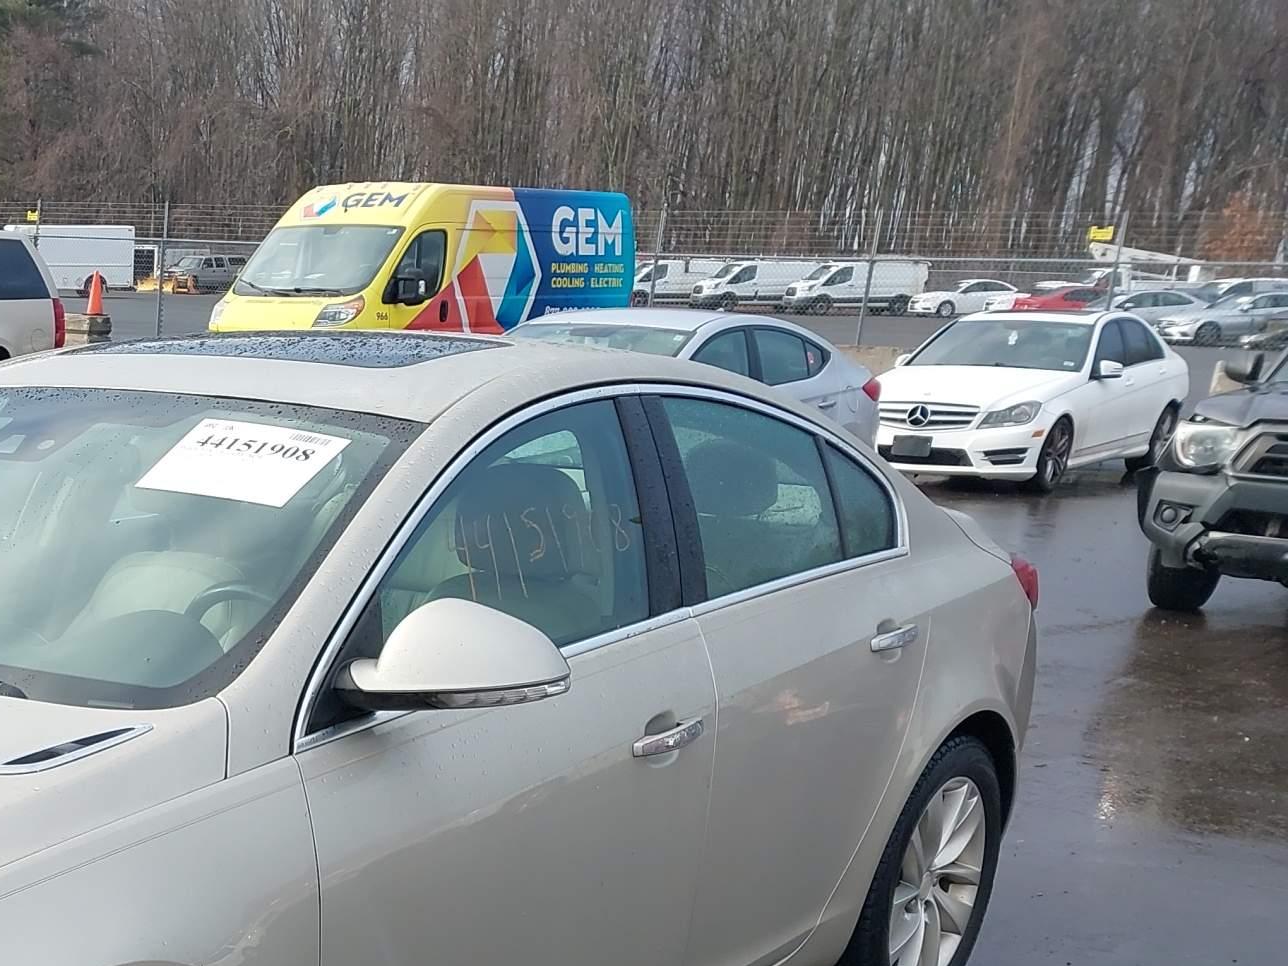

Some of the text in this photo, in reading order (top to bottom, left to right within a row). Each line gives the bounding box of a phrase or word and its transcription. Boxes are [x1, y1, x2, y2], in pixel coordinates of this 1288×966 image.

[342, 192, 409, 208] GEM
[551, 206, 622, 256] GEM
[551, 263, 624, 273] PLUMBING HEATING
[551, 277, 623, 288] COOLING ELECTRIC
[196, 434, 316, 462] 44151908
